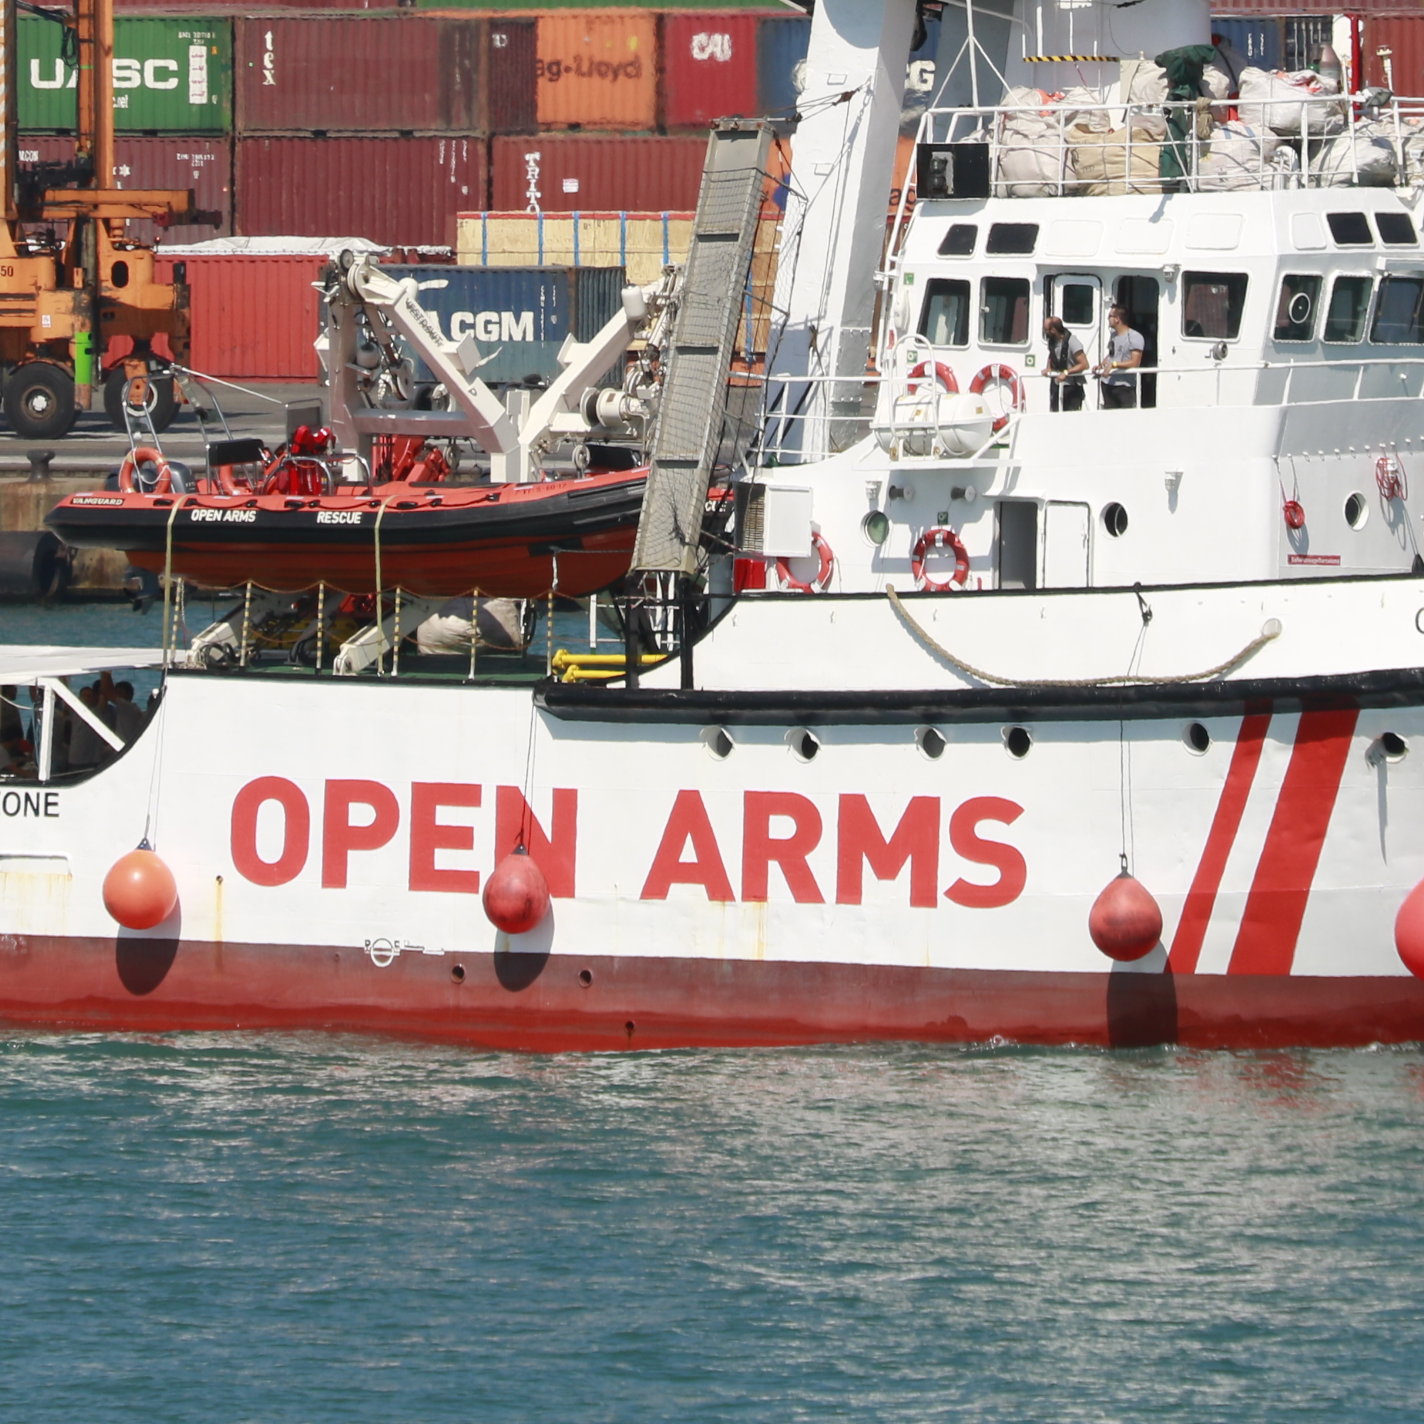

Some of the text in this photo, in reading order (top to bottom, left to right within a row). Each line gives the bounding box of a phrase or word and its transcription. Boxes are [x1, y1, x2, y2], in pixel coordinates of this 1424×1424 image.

[262, 30, 276, 86] tex
[30, 58, 179, 90] USC
[450, 311, 534, 342] CGM
[72, 496, 123, 506] VANGUARD
[191, 509, 362, 524] OPEN ARMS RESCUE
[230, 775, 1028, 909] OPEN ARMS
